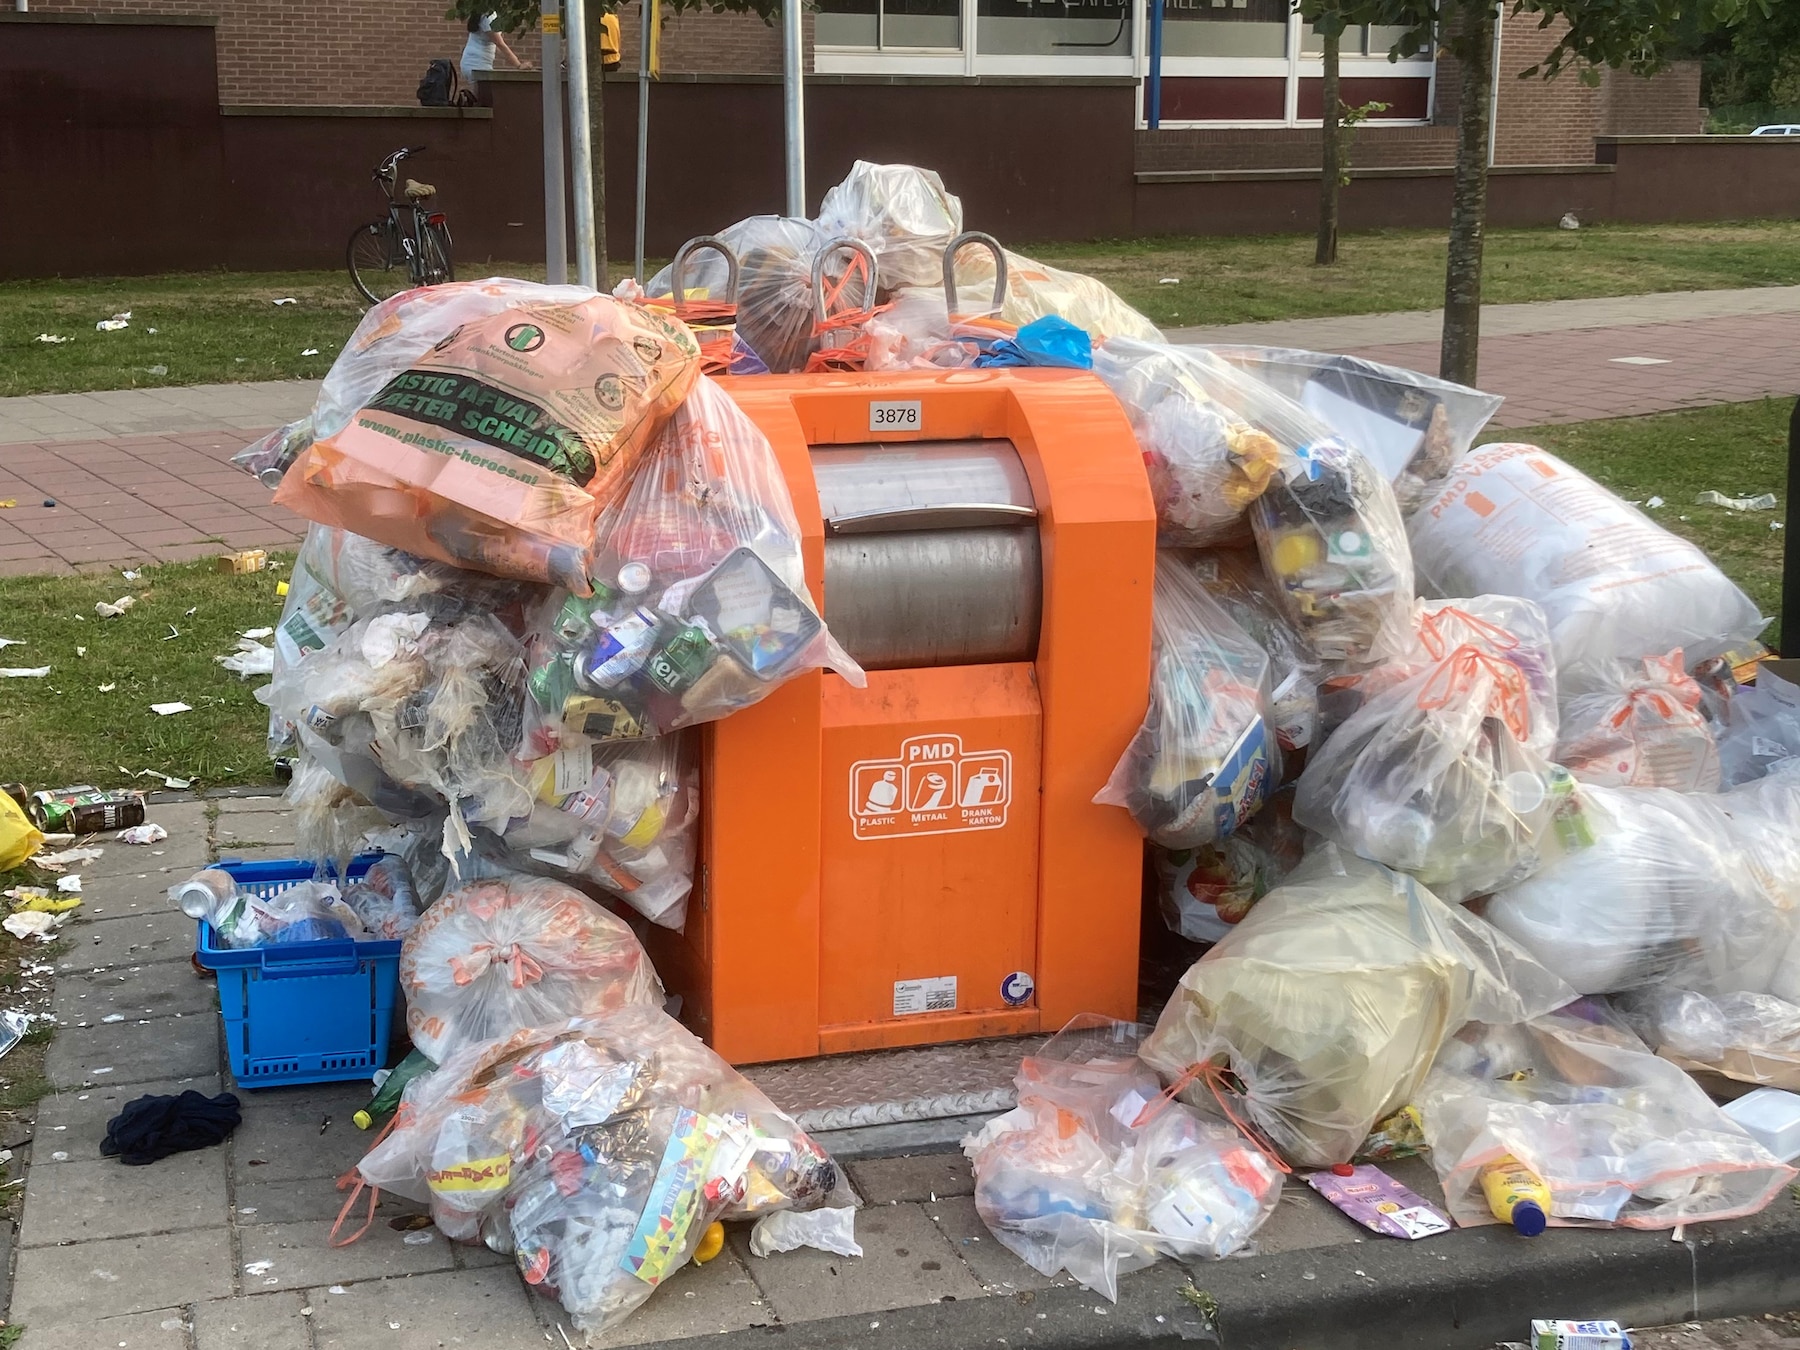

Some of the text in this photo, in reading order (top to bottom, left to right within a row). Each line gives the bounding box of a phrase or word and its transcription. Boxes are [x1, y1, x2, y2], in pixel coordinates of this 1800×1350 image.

[457, 383, 541, 428] AFVAL
[875, 408, 917, 423] 3878
[358, 417, 539, 485] www.plastic-heroes.nl
[1430, 480, 1468, 518] PMD
[909, 742, 955, 761] PMD
[860, 808, 993, 828] PLASTIC METAAL DRANK
[968, 815, 1002, 826] KARTON
